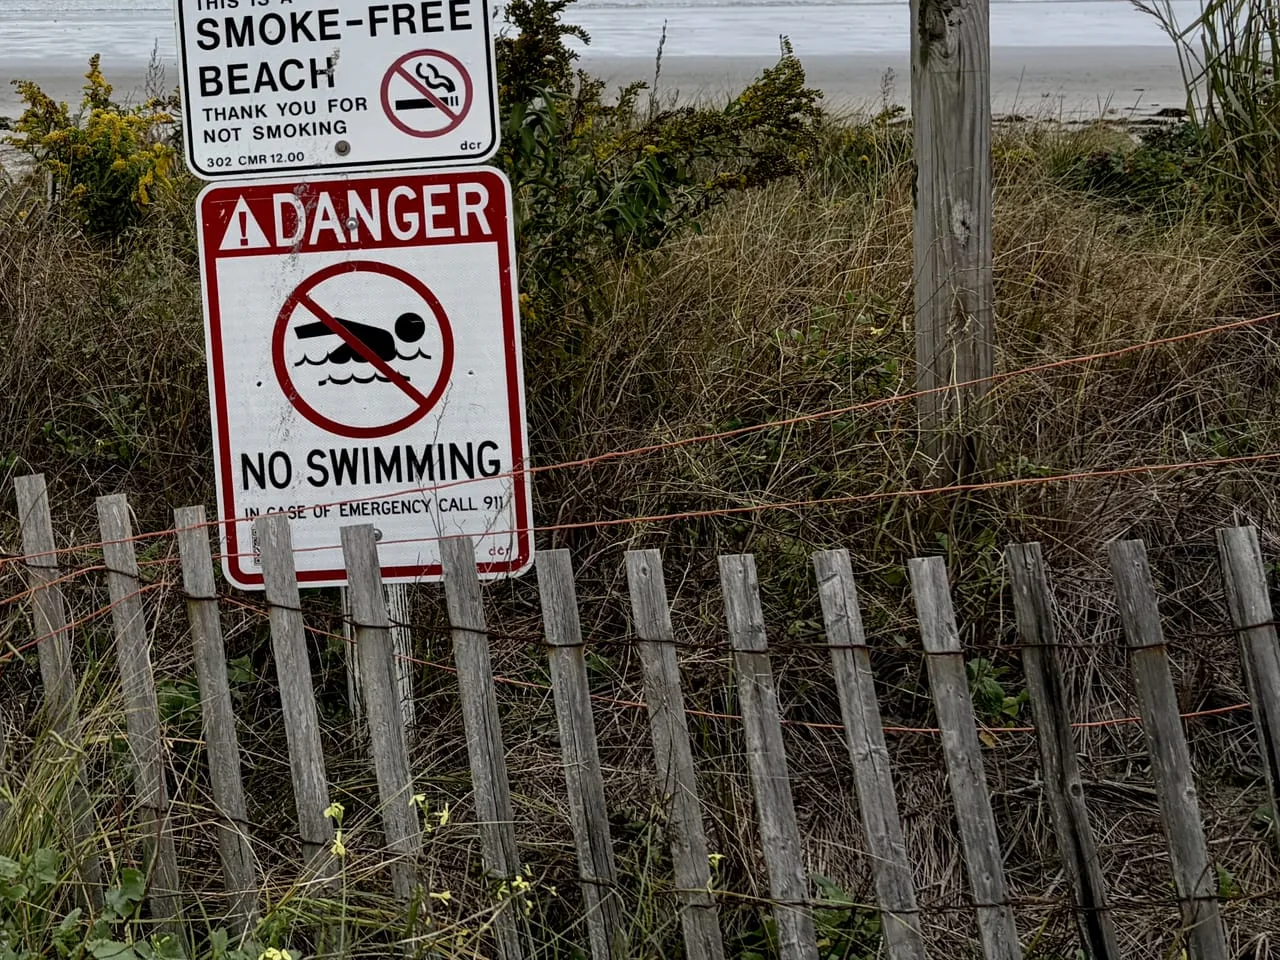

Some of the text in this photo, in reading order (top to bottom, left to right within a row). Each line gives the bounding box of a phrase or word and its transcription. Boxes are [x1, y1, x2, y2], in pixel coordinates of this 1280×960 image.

[198, 56, 336, 97] BEACH
[202, 97, 368, 122] THANK YOU FOR
[203, 120, 347, 144] NOT SMOKING
[460, 140, 482, 152] dcr
[207, 152, 305, 168] 302 CMR 12.00
[272, 182, 493, 247] DANGER
[240, 440, 501, 491] NO SWIMMING
[245, 507, 259, 521] IN
[313, 504, 331, 518] OF
[340, 498, 431, 517] EMERGENCY
[439, 497, 478, 512] CALL
[483, 495, 503, 510] 911
[489, 546, 511, 556] dcr
